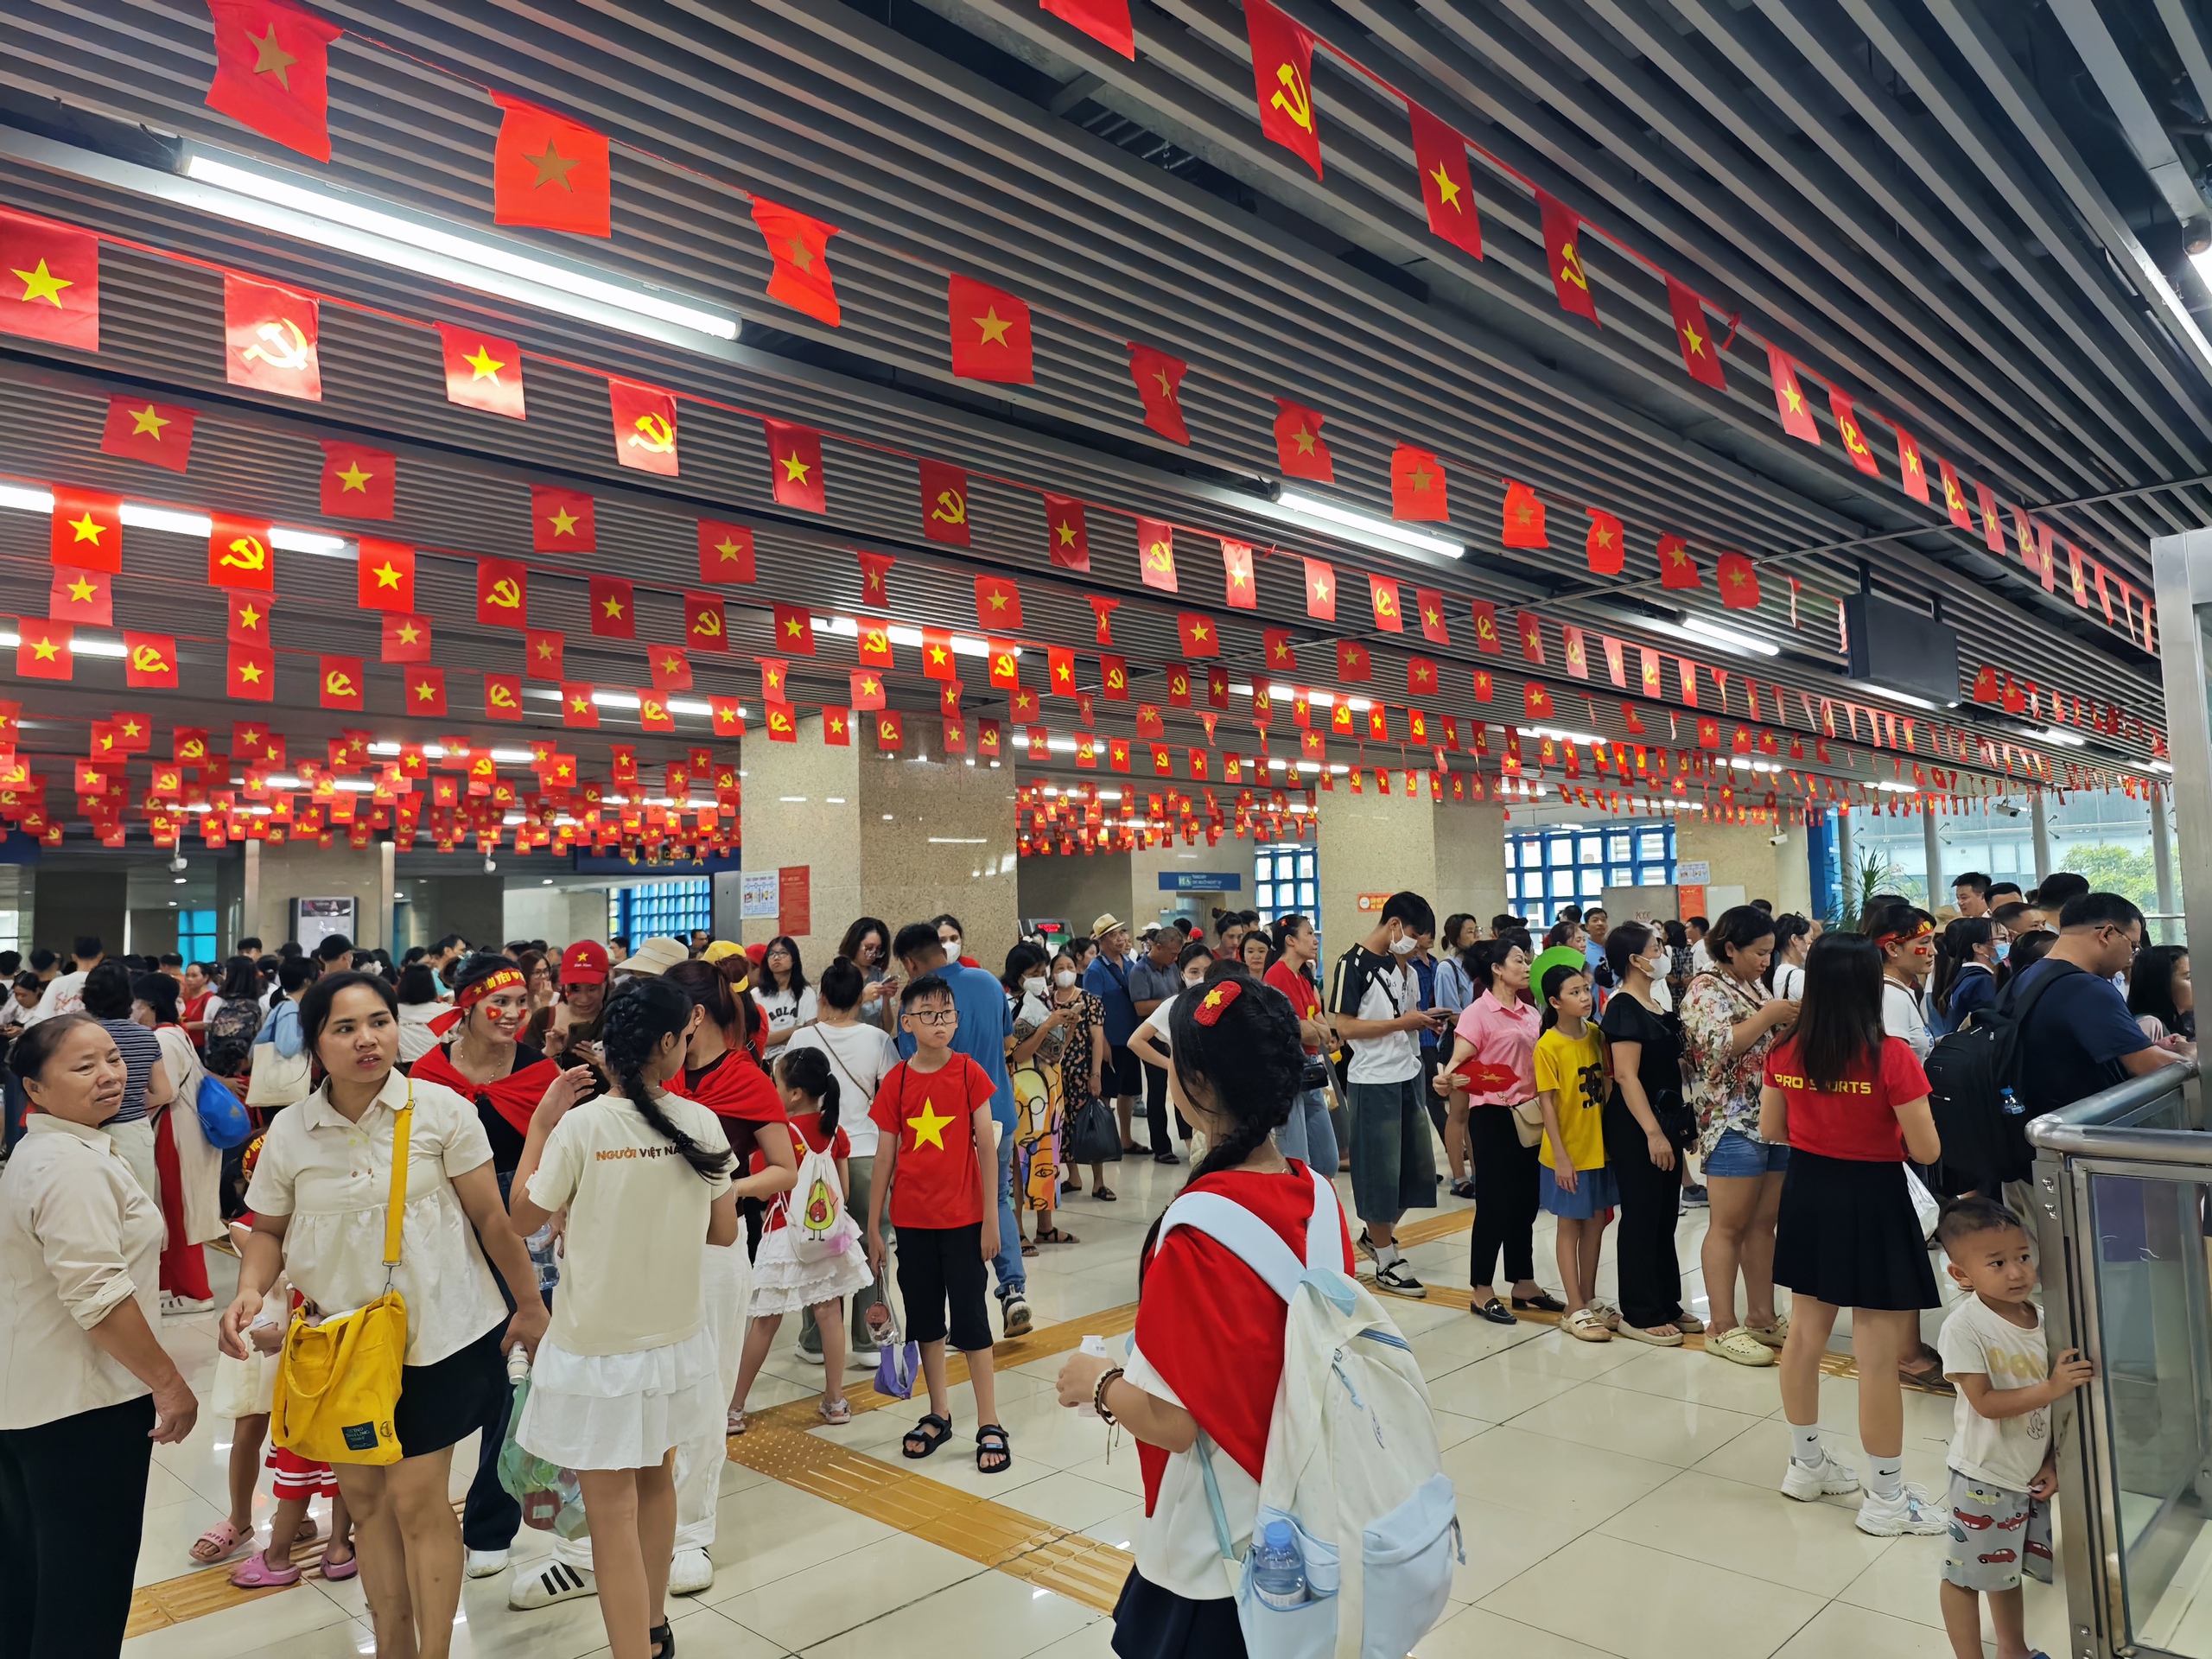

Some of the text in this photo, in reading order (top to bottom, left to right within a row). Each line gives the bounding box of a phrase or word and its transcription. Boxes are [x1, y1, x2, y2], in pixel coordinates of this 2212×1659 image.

[1774, 1073, 1804, 1089] PRO
[595, 1146, 682, 1161] NGƯỜI VIỆT NA
